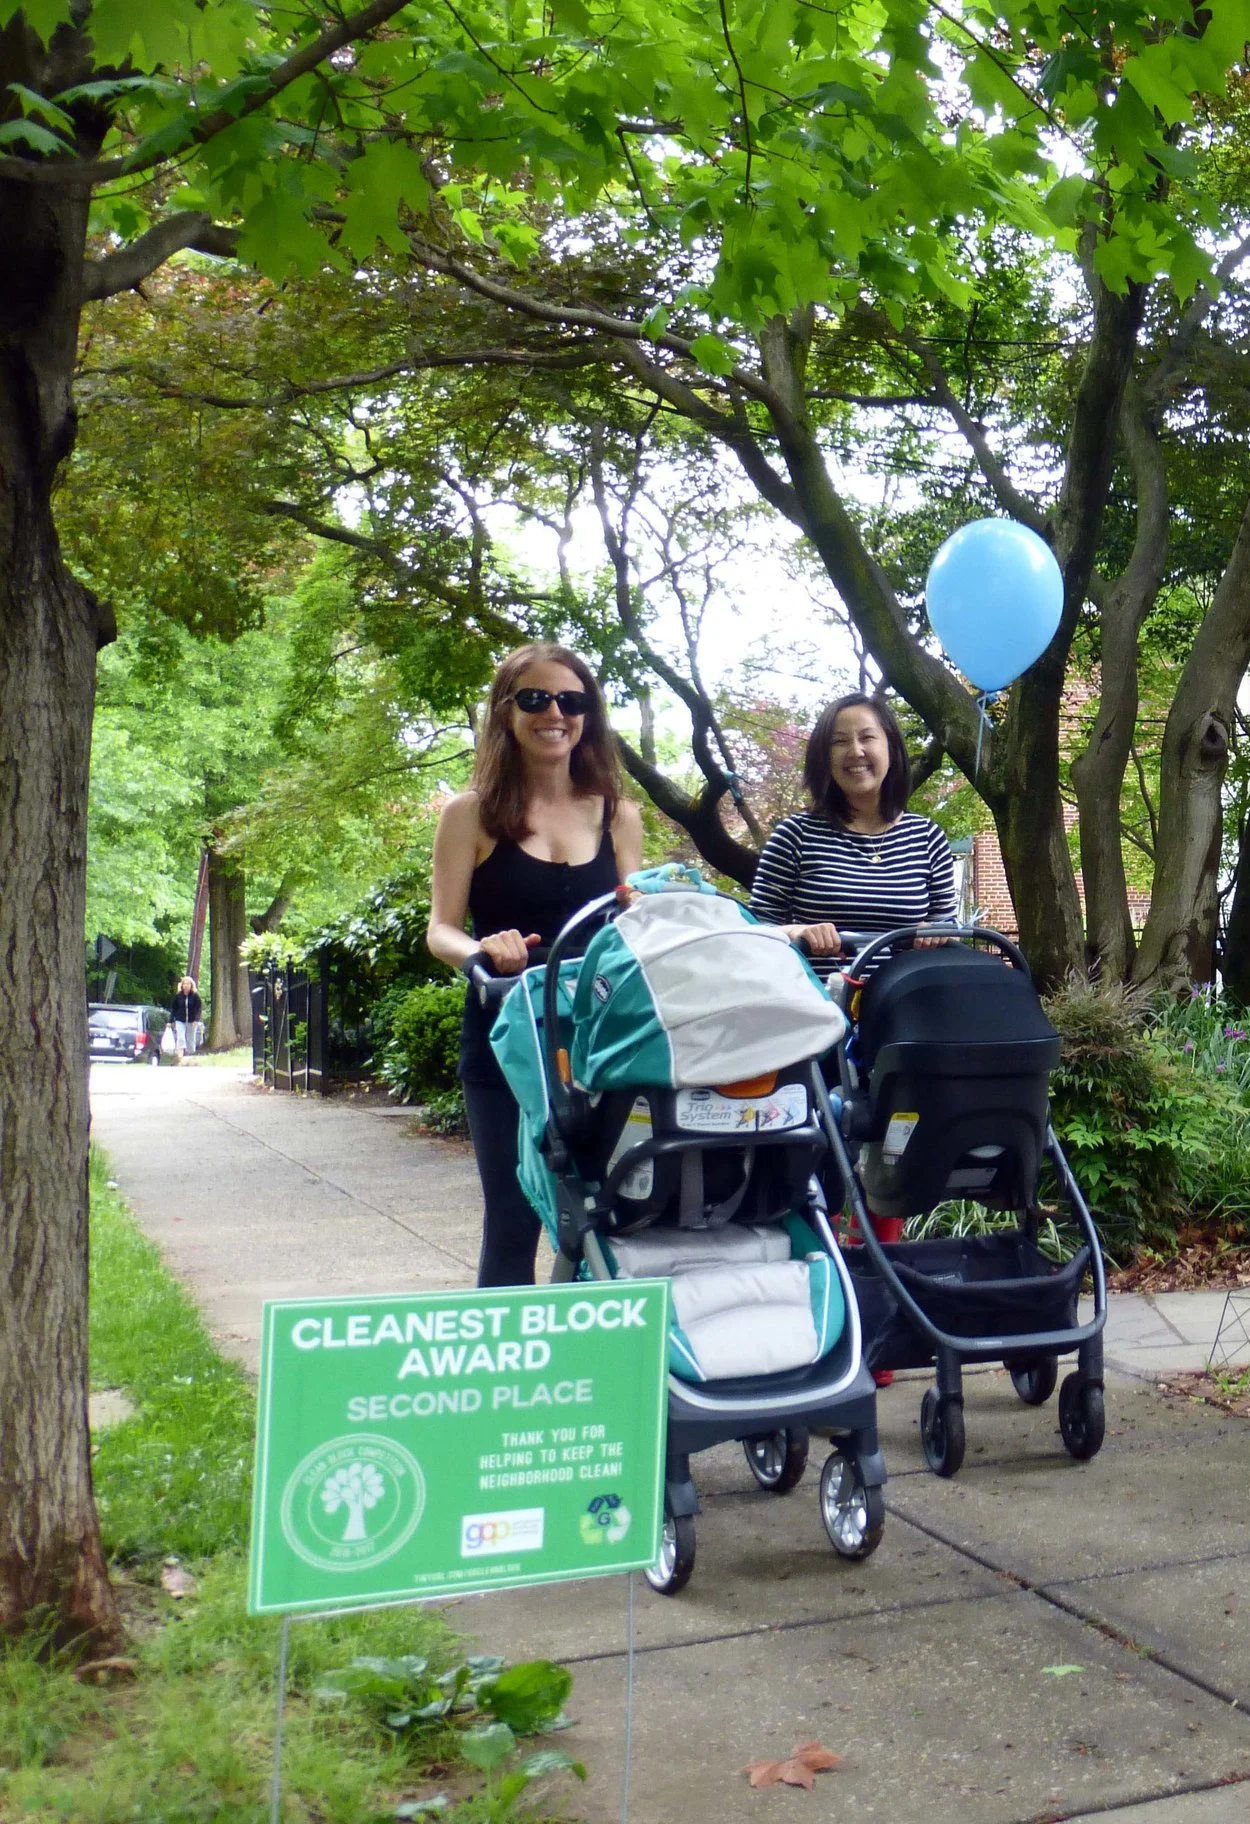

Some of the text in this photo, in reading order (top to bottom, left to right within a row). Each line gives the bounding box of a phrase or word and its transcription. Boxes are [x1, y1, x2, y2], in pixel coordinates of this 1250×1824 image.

[680, 1111, 731, 1122] System
[291, 1298, 648, 1349] CLEANEST BLOCK
[397, 1340, 551, 1379] AWARD
[347, 1378, 593, 1421] SECOND PLACE
[501, 1424, 606, 1447] THANK YOU FOR
[480, 1441, 624, 1470] HELPING TO KEEP THE
[480, 1461, 622, 1490] NEIGHBORHOOD CLEAN!
